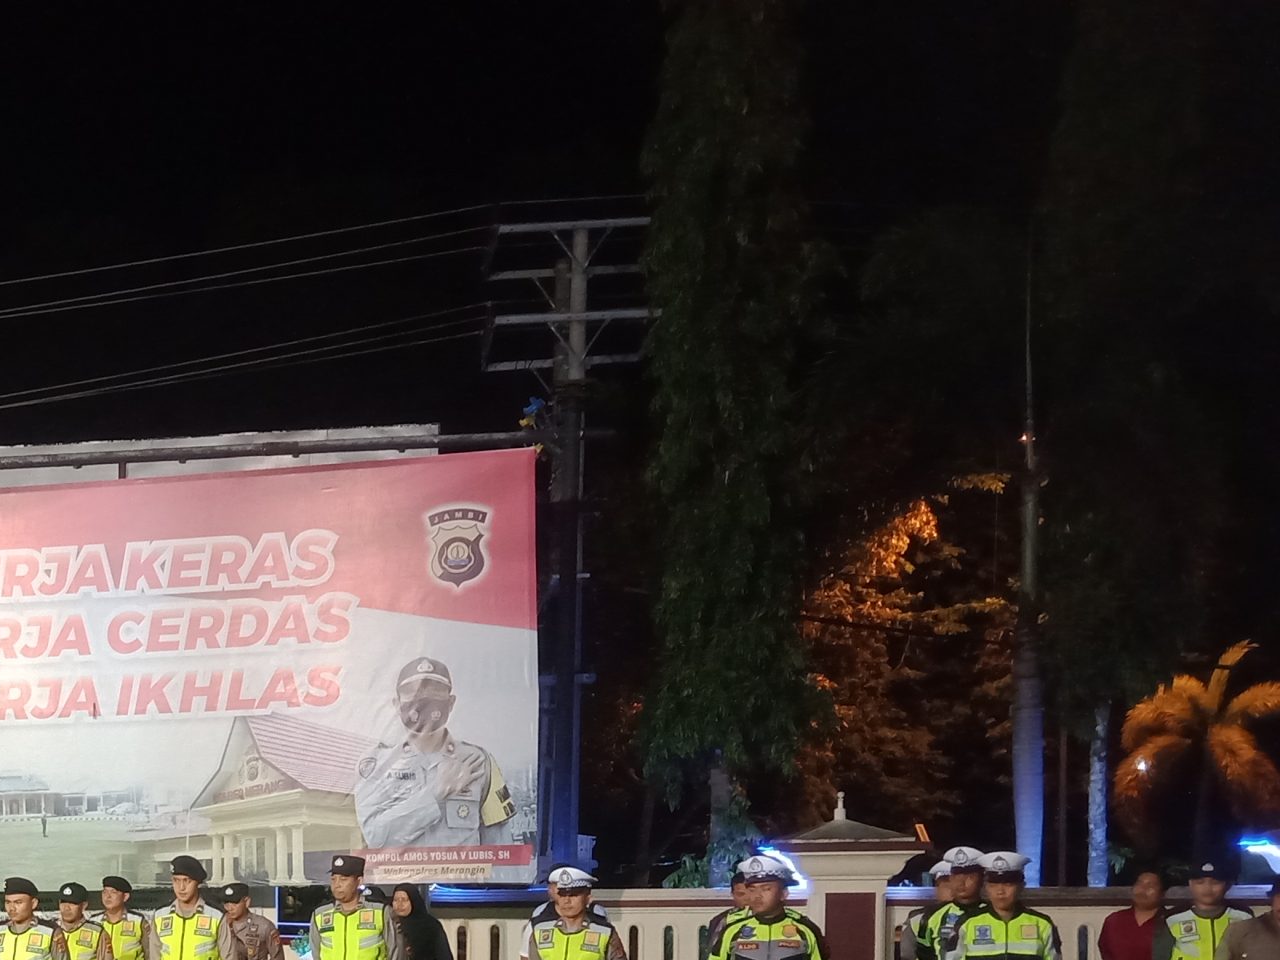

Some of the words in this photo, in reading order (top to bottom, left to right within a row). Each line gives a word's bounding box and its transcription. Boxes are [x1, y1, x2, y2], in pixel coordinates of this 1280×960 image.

[433, 511, 483, 523] JAMBI
[122, 534, 335, 591] KERAS
[107, 597, 353, 654] CERDAS
[116, 665, 344, 716] IKHLAS
[366, 852, 401, 862] KOMPOL
[403, 851, 427, 861] AMOS
[430, 851, 458, 861] YOSUA
[460, 852, 466, 860] V
[469, 850, 496, 861] LUBIS,
[498, 850, 510, 860] SH
[440, 865, 486, 877] Merangin
